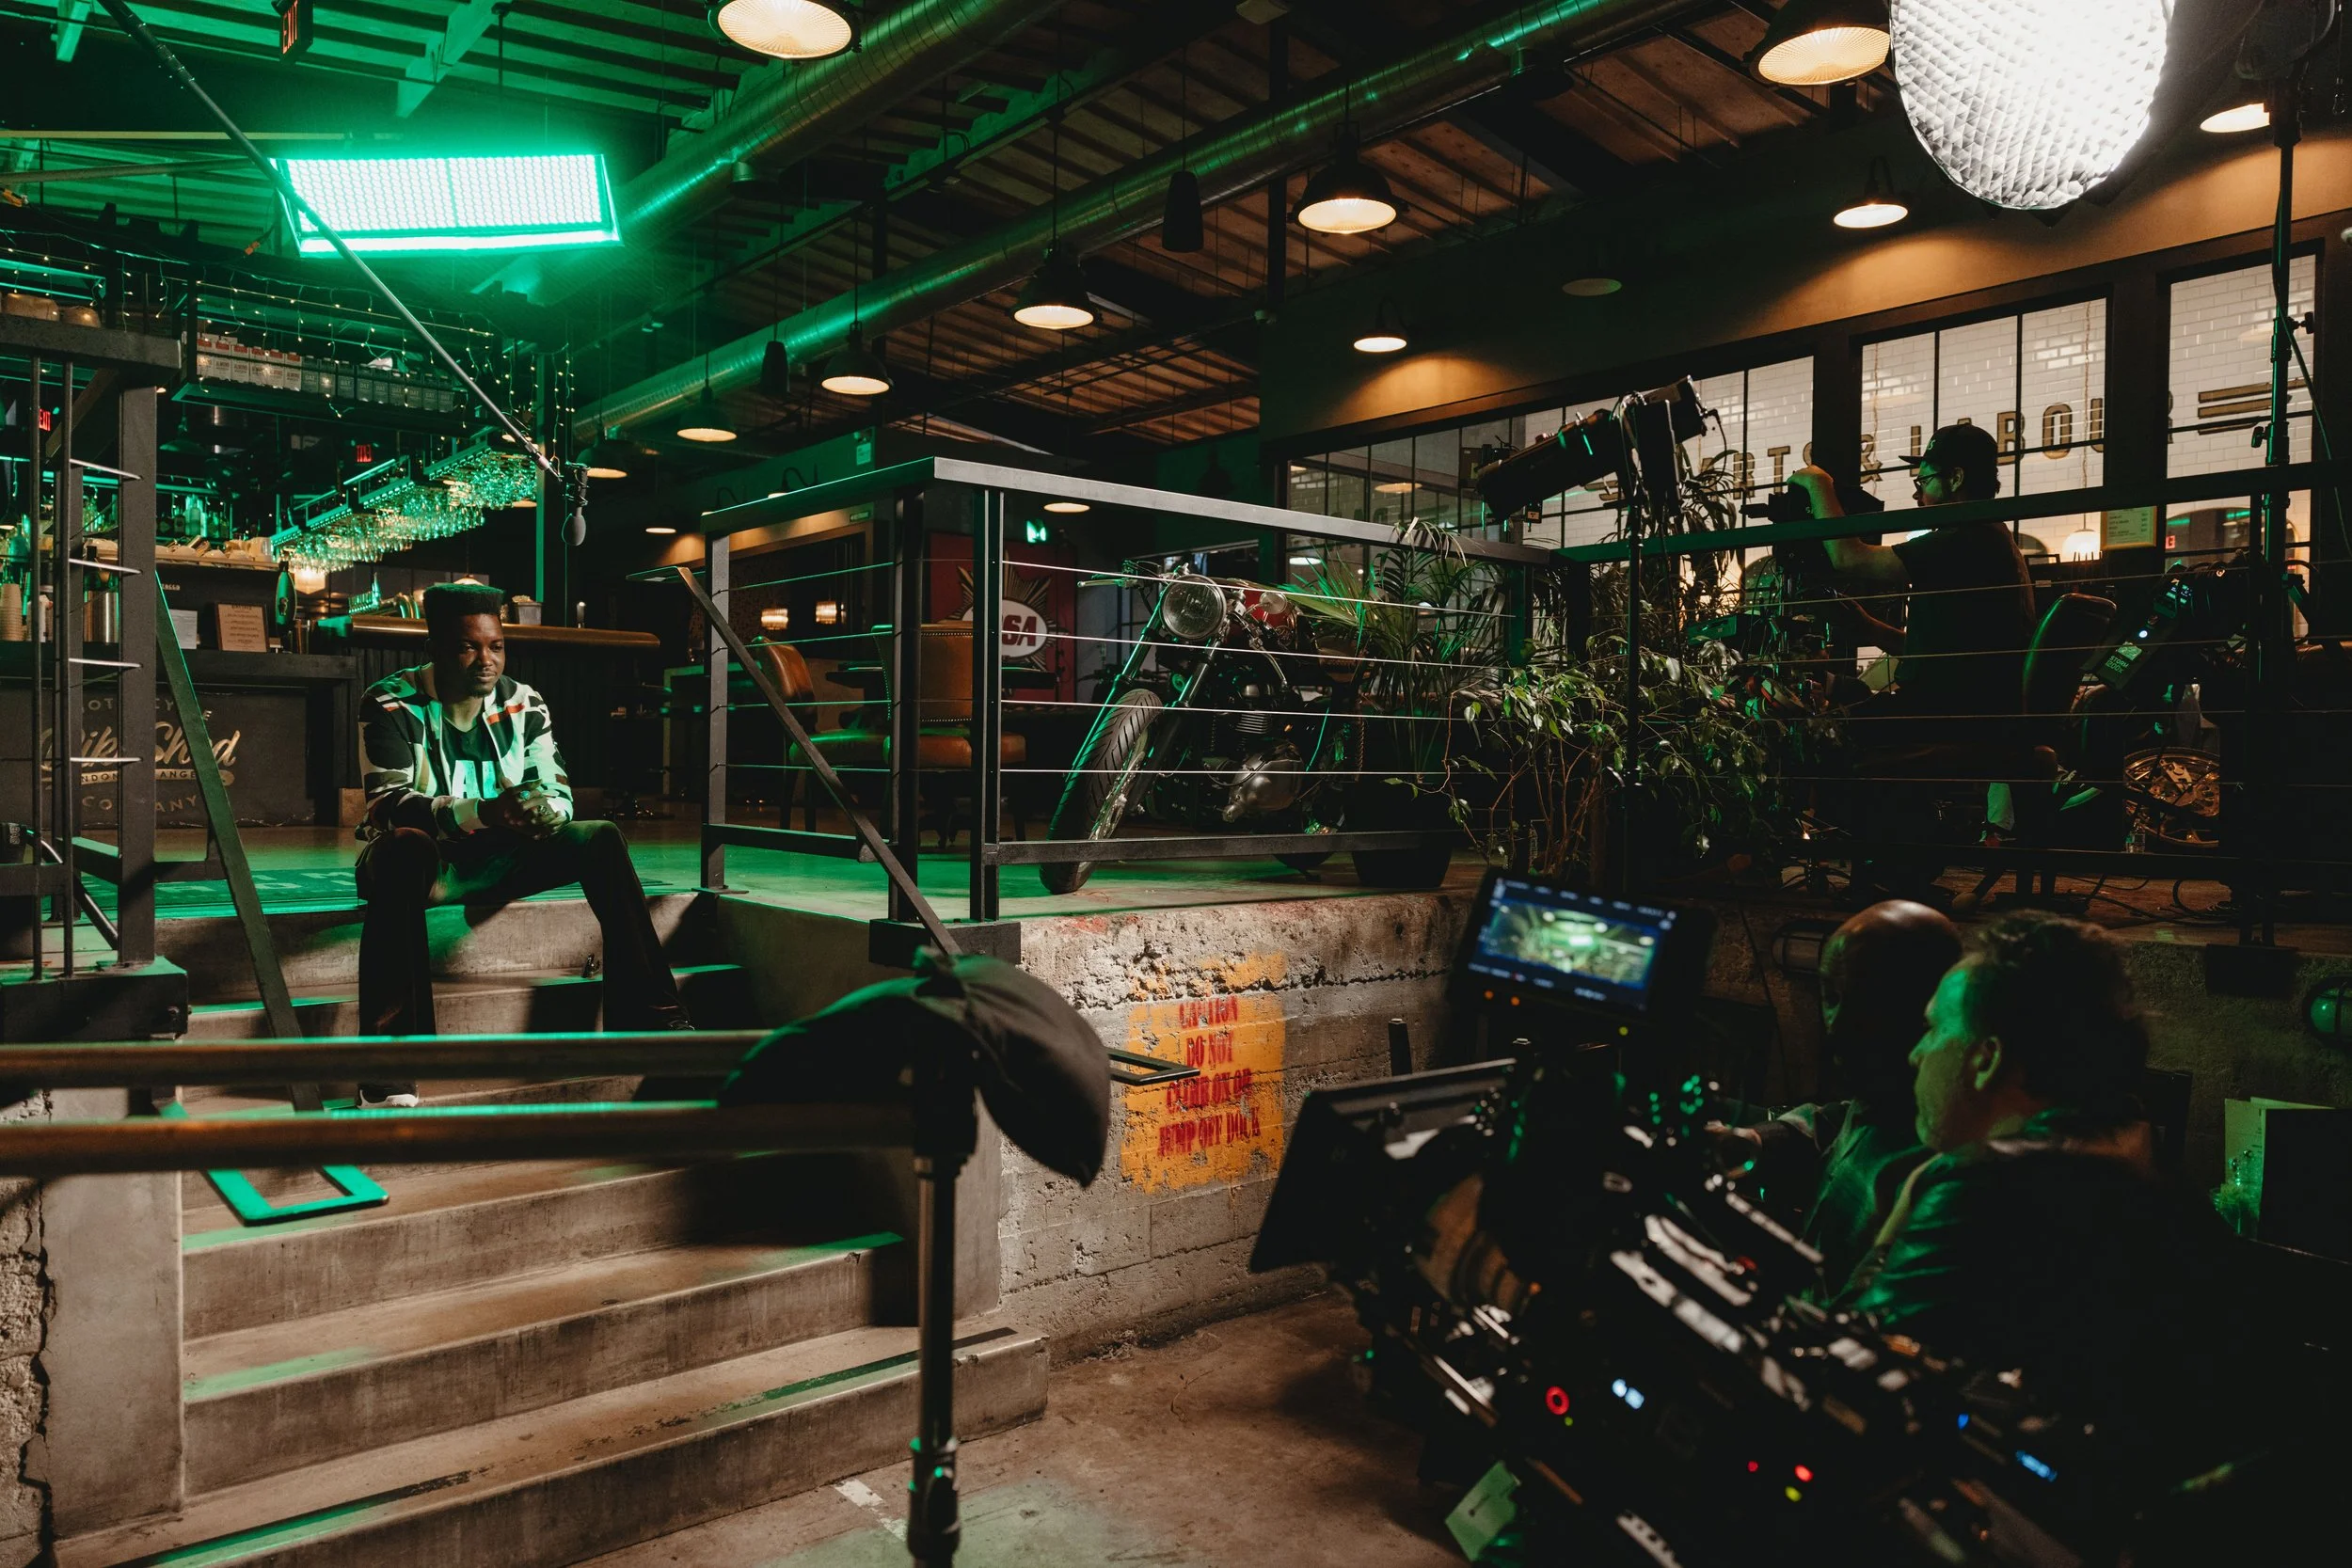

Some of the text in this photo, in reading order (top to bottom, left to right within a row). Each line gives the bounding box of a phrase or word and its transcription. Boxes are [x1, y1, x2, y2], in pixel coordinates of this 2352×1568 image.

[282, 0, 298, 55] EXIT
[1002, 613, 1037, 647] SA
[2107, 656, 2130, 669] STORM
[82, 795, 197, 813] COANY
[1179, 995, 1238, 1029] CAUTION
[1186, 1029, 1234, 1069] DO NOT
[1166, 1068, 1253, 1114] CLIMB ON OR
[1158, 1106, 1262, 1158] JUMP OFF DOCK
